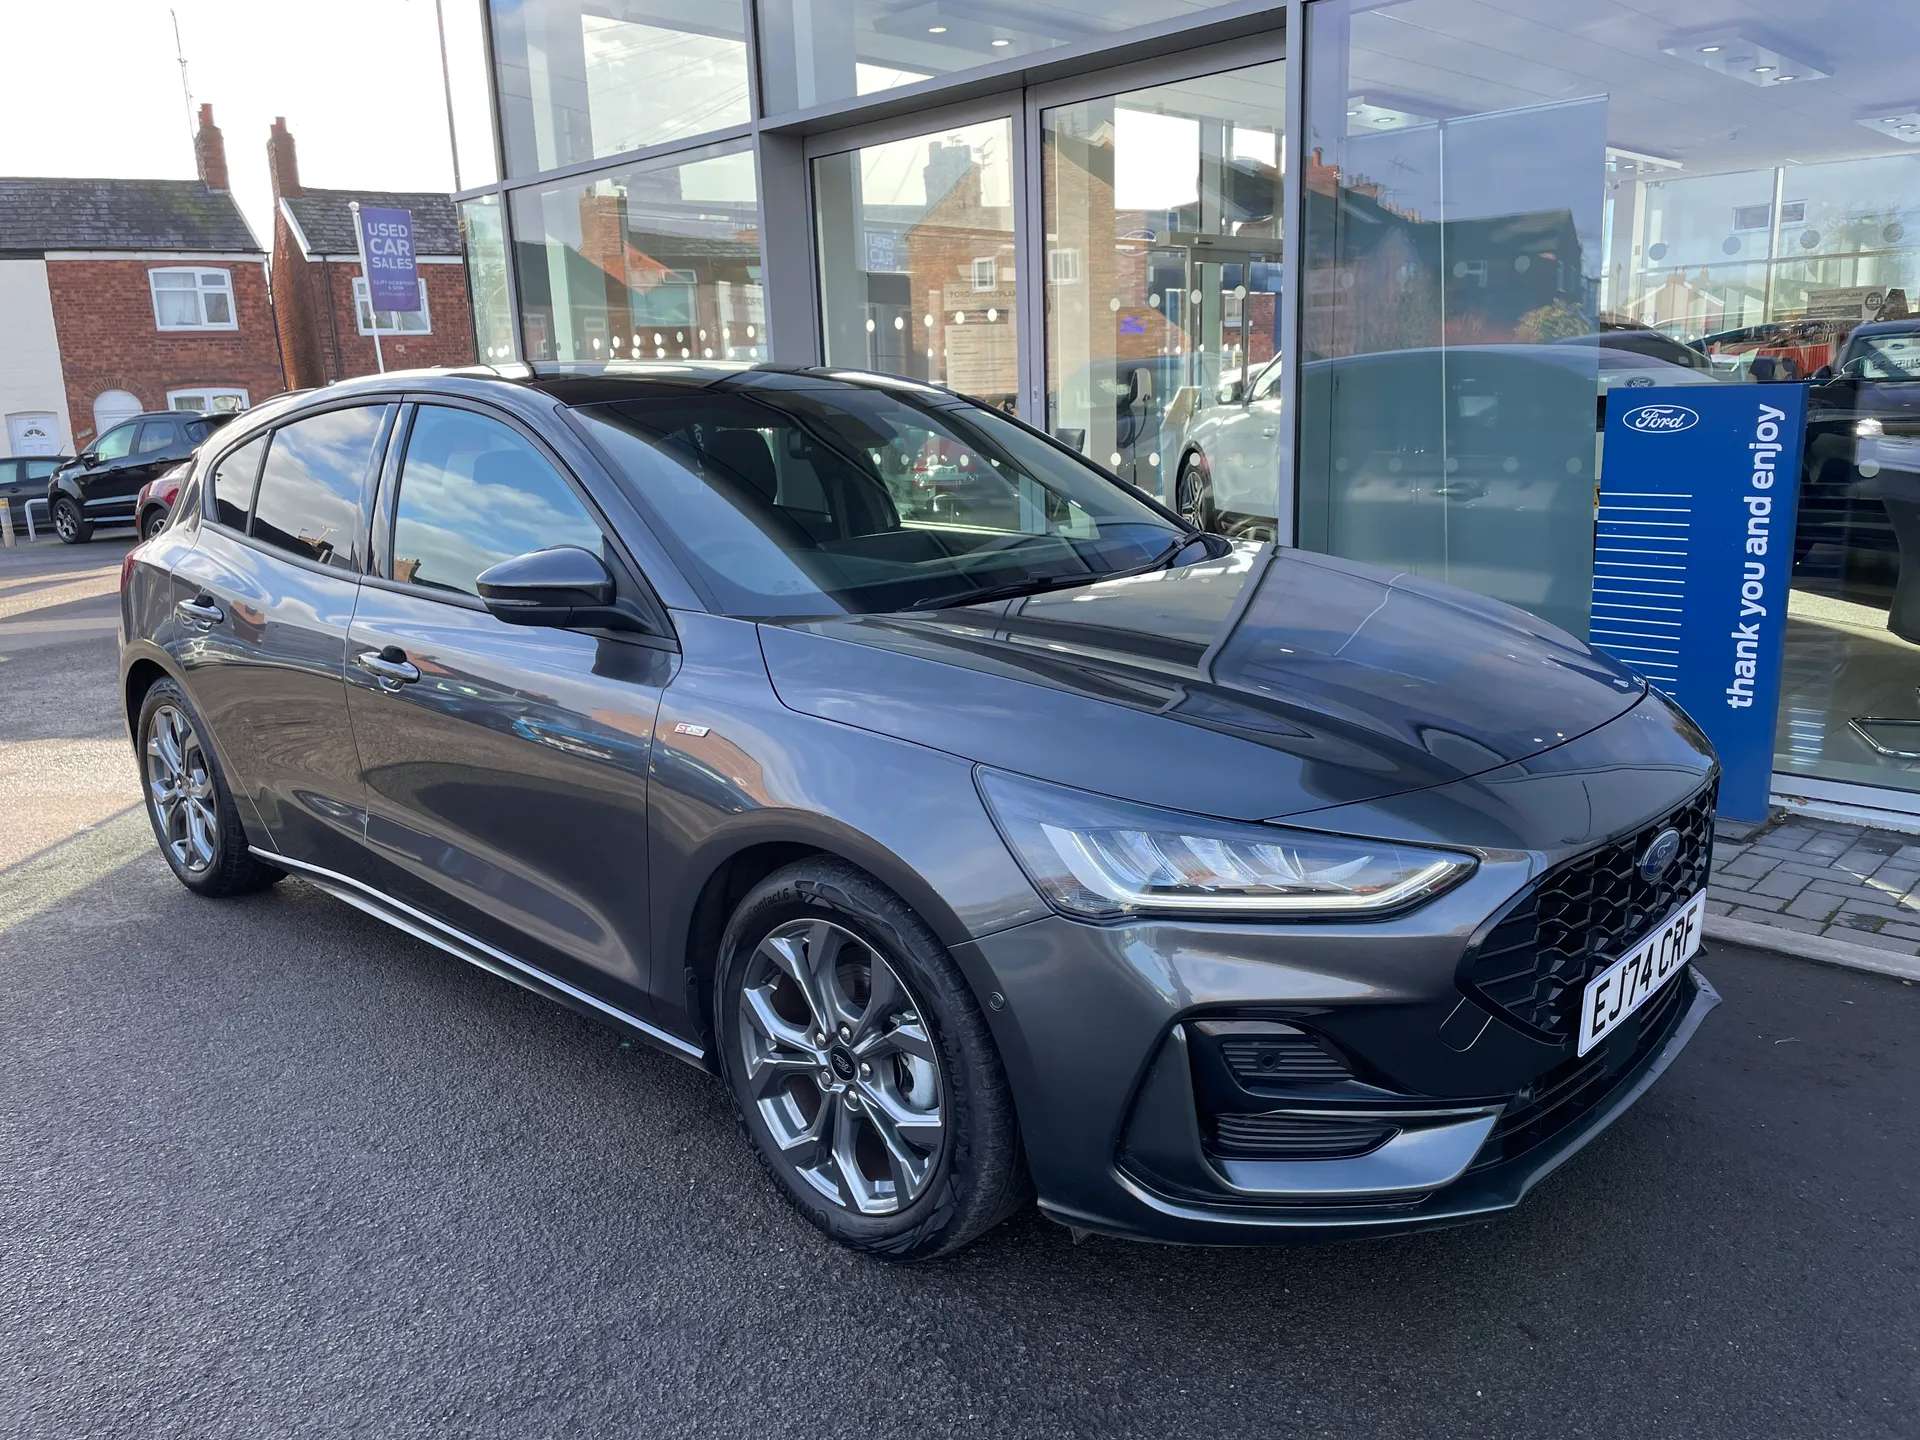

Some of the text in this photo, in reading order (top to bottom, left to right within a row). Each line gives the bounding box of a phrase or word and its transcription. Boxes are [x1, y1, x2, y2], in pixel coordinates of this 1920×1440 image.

[368, 223, 408, 237] USED
[370, 238, 410, 256] CAR
[372, 257, 413, 269] SALES
[1636, 408, 1686, 428] Ford
[1726, 404, 1785, 708] thank you and enjoy
[1591, 903, 1698, 1038] EJ74 CRF
